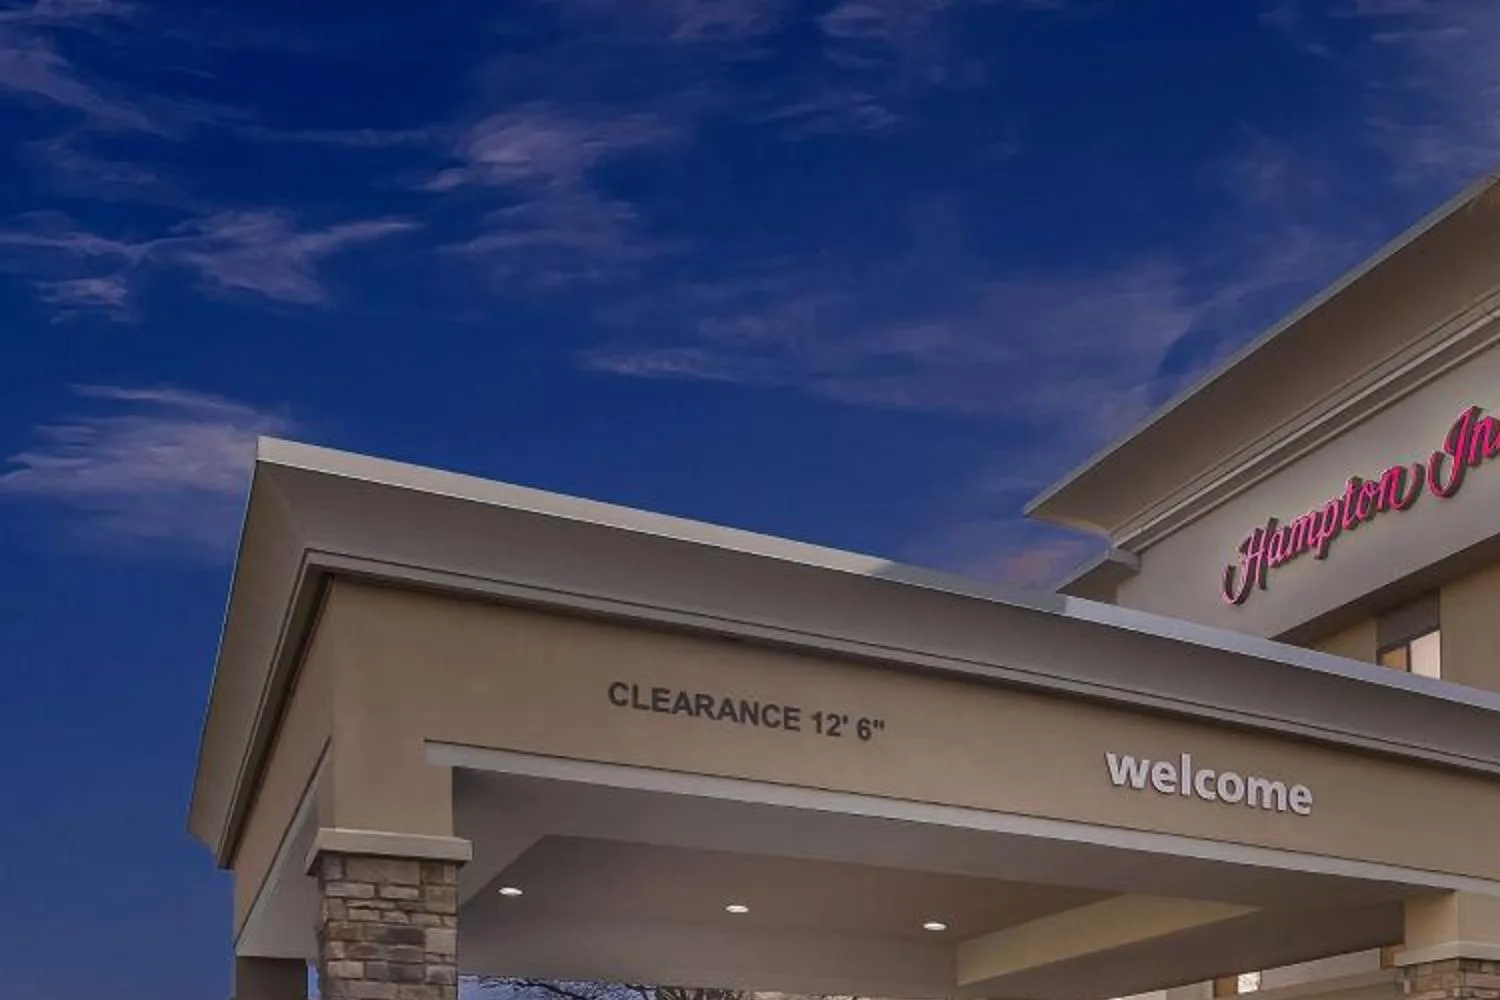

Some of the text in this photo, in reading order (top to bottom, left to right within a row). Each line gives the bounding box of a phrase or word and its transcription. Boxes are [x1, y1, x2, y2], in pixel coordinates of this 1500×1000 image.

[1221, 463, 1426, 606] Hampton
[607, 681, 801, 732] CLEARANCE
[810, 710, 849, 738] 12'
[1105, 751, 1313, 815] welcome
